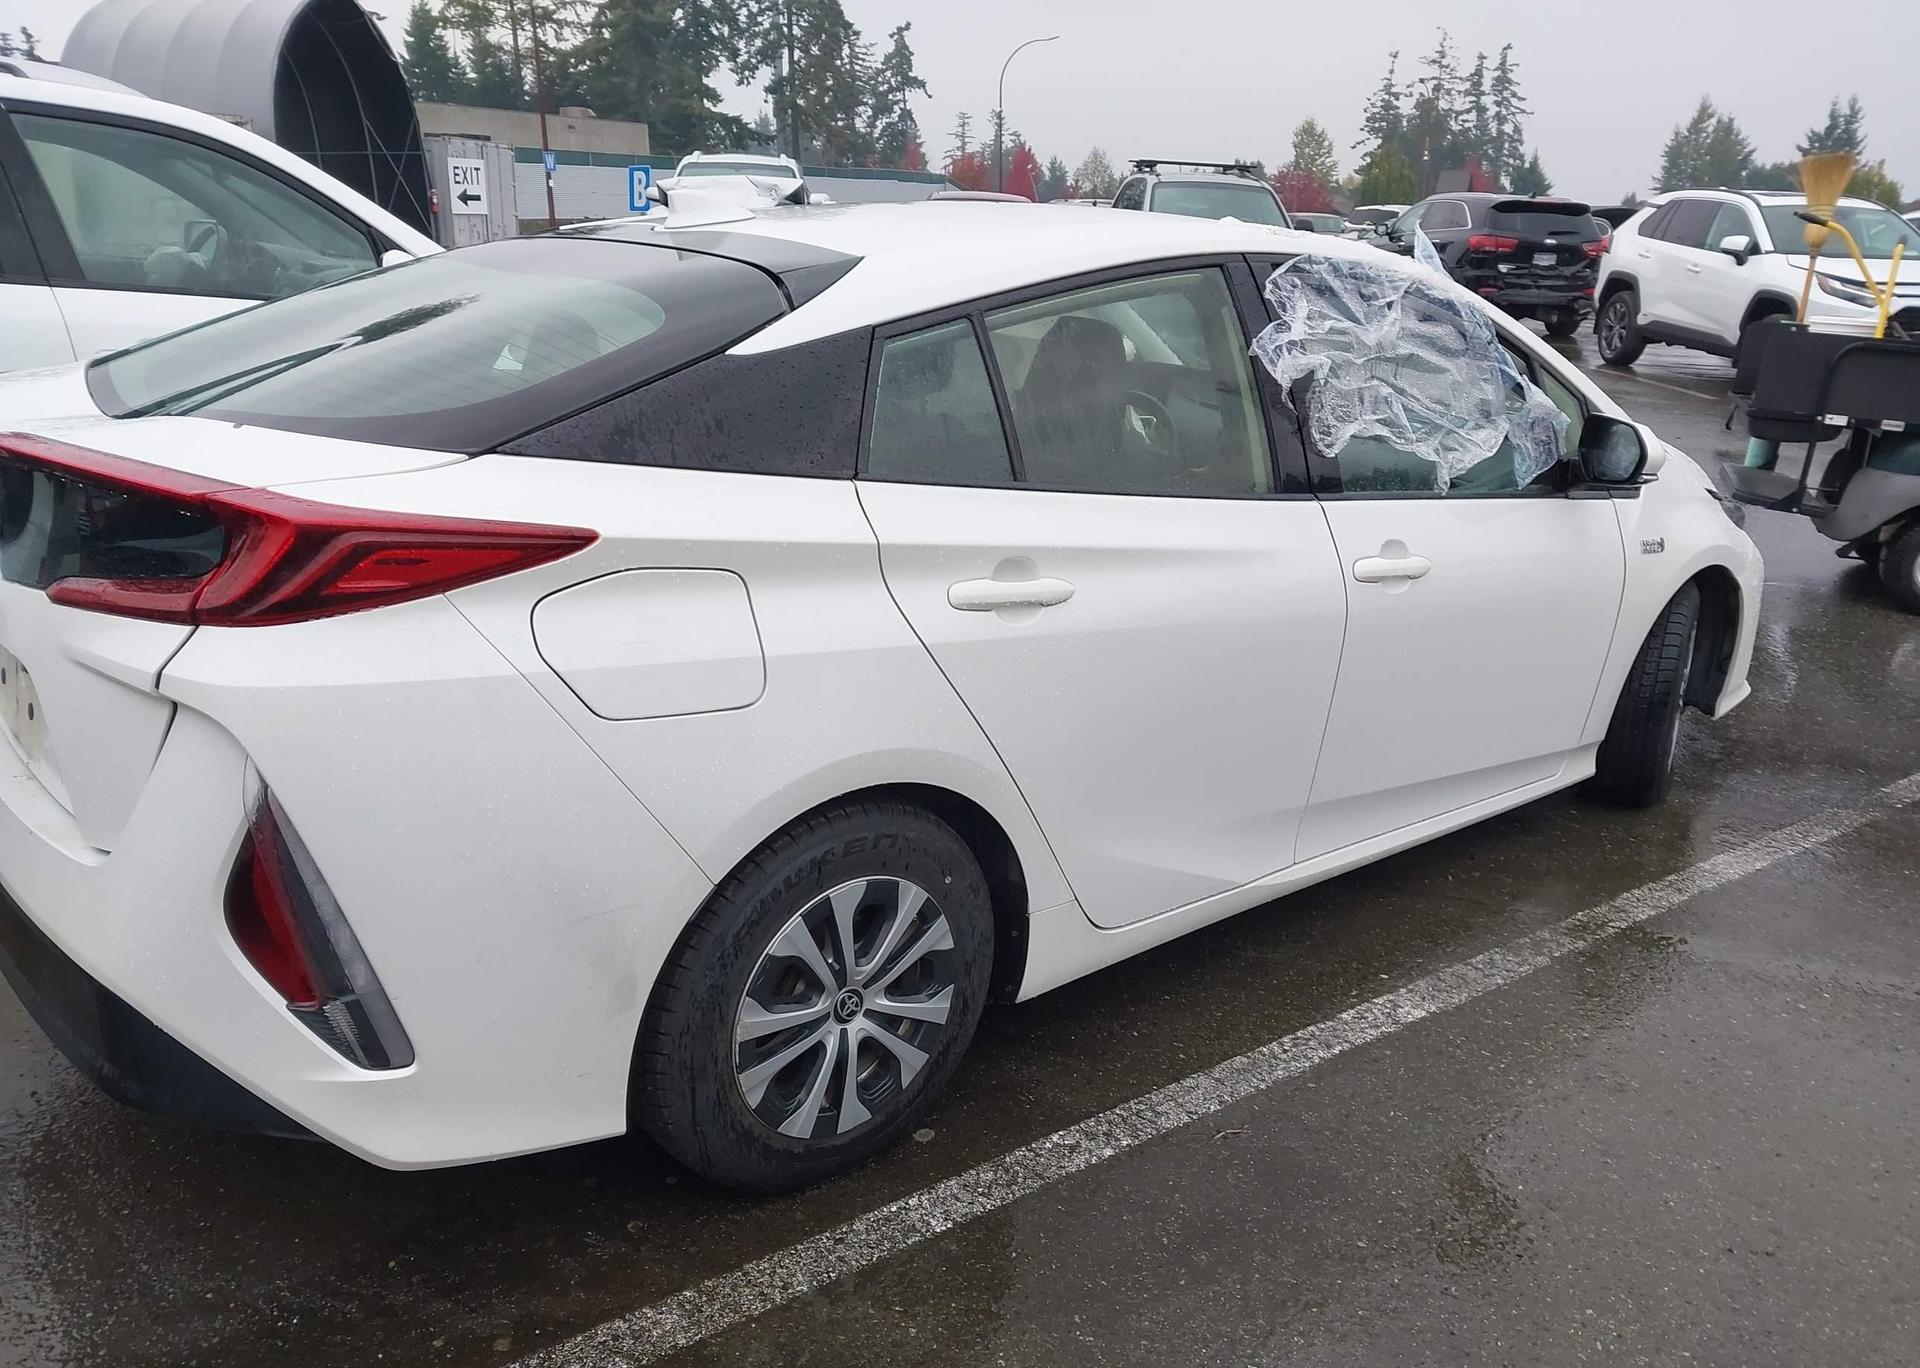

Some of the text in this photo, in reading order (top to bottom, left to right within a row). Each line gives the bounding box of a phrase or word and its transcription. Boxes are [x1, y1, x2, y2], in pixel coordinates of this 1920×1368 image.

[544, 153, 555, 169] W
[453, 165, 481, 186] EXIT
[633, 170, 647, 208] B
